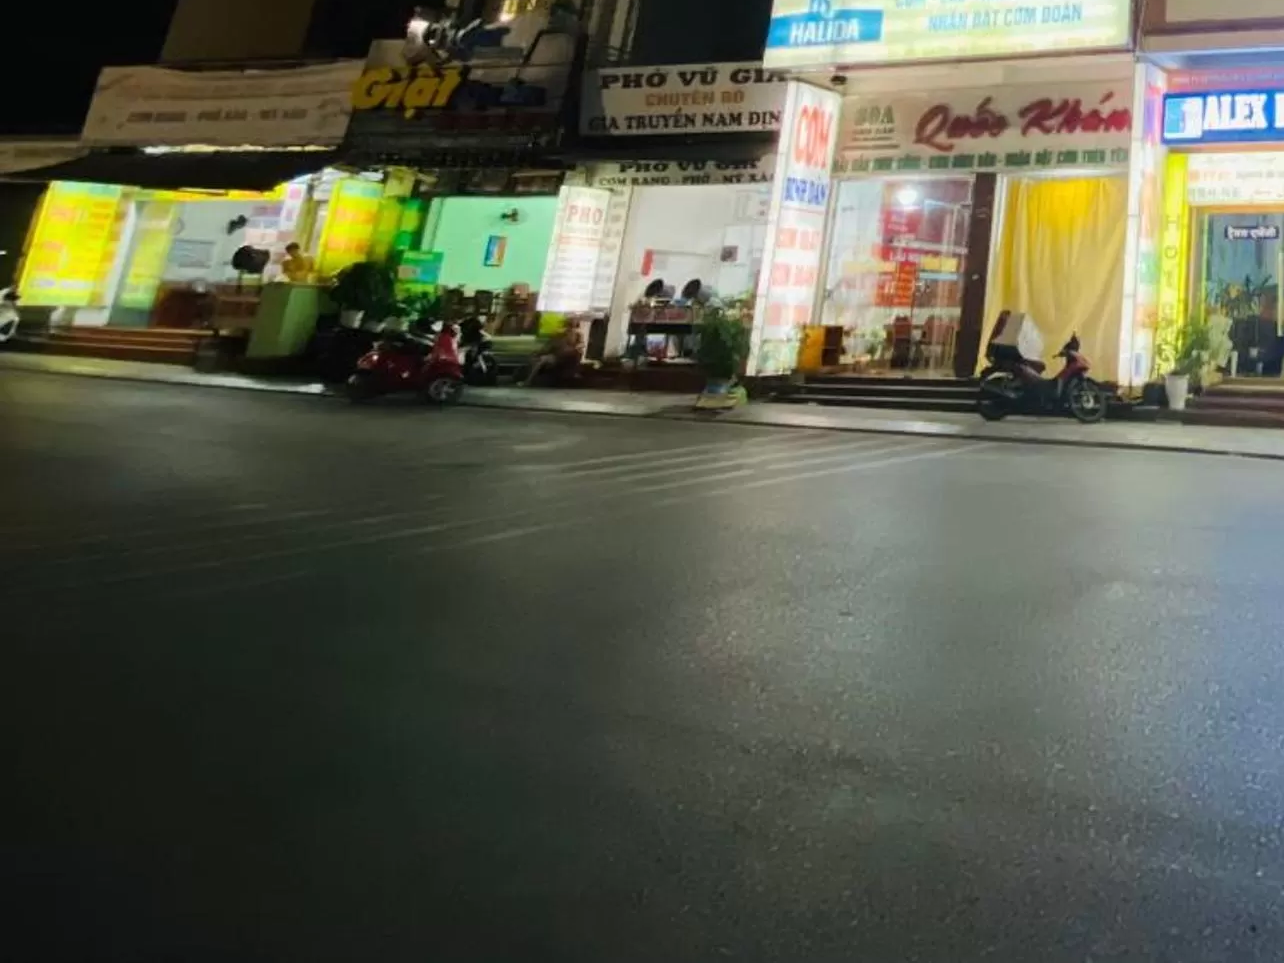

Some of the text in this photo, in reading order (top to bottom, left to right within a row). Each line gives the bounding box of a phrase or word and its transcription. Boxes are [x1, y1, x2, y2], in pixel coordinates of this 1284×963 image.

[790, 17, 860, 44] HALIDA
[702, 112, 742, 127] NAM
[747, 110, 781, 129] ĐỊN
[1203, 92, 1268, 130] ALEX
